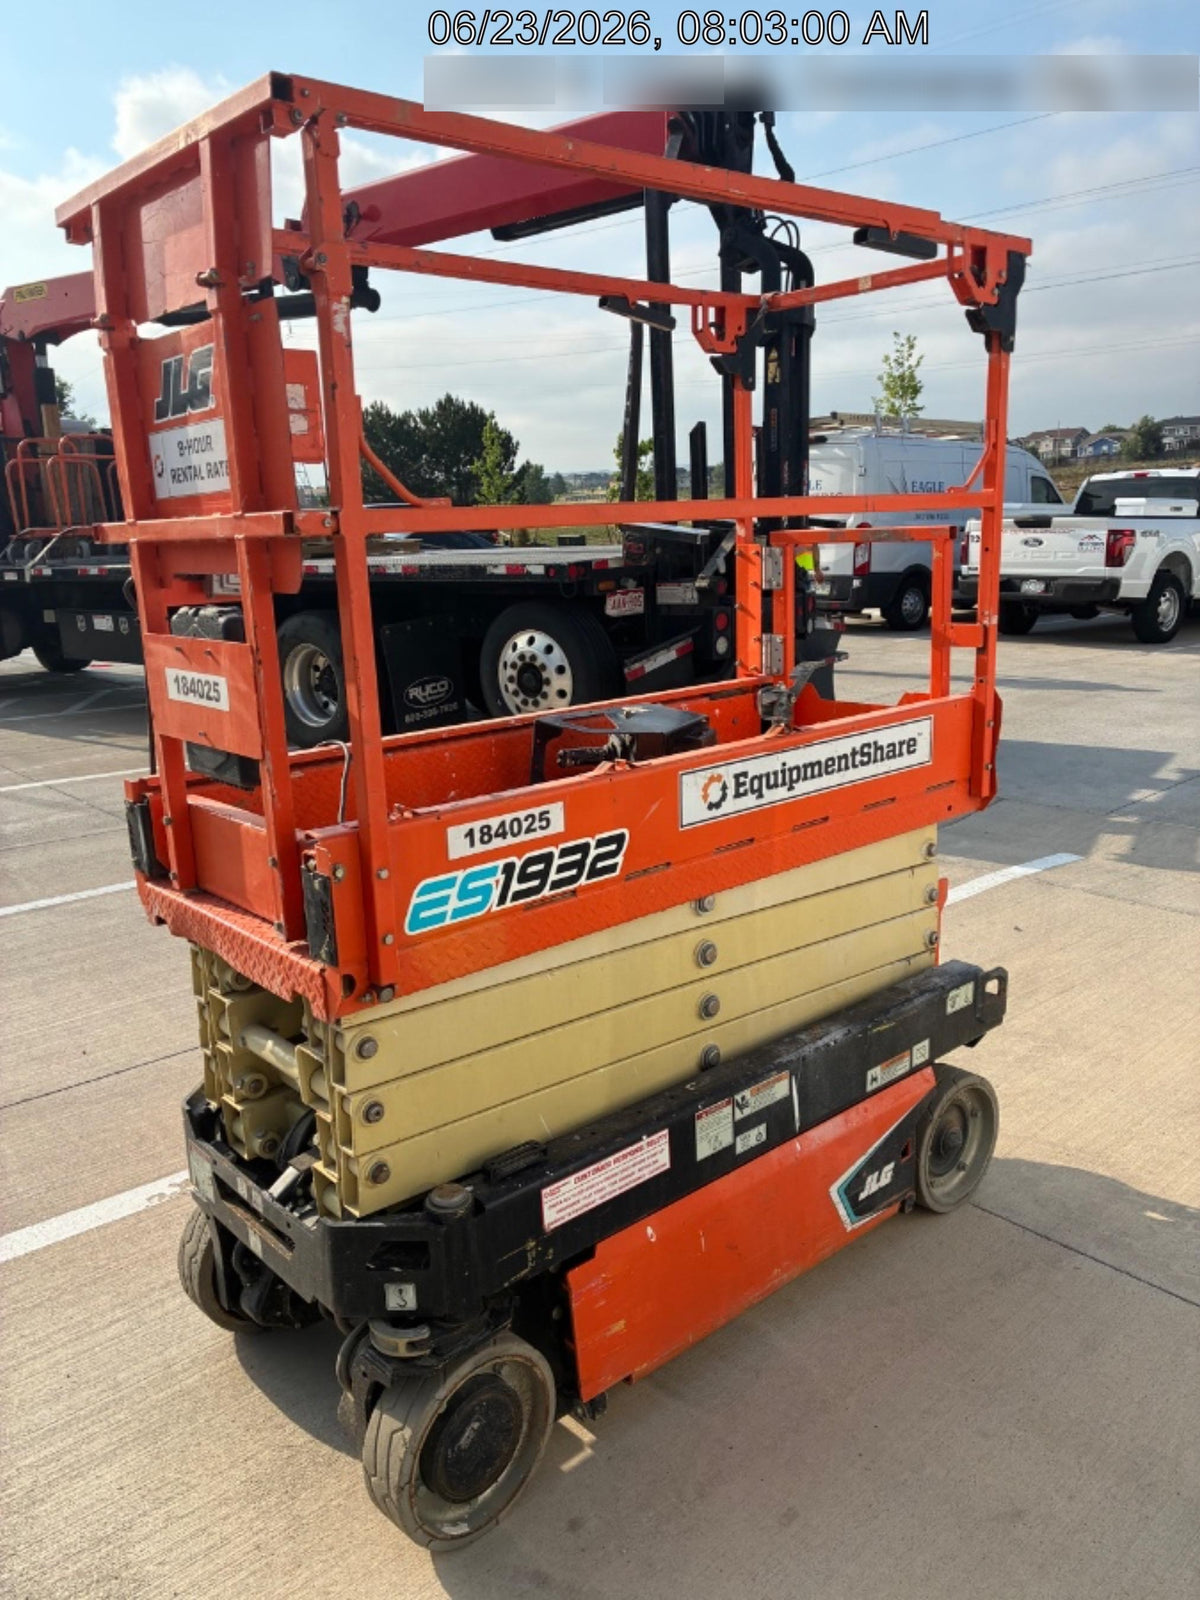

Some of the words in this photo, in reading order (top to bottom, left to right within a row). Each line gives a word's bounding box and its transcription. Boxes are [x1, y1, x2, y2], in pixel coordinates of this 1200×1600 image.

[154, 343, 216, 424] JLG
[177, 434, 214, 458] 8-HOUR
[169, 463, 206, 485] RENTAL
[911, 480, 946, 494] EAGLE
[173, 674, 222, 703] 184025
[463, 809, 552, 849] 184025
[405, 829, 630, 935] ES1932
[857, 1160, 897, 1202] JLG
